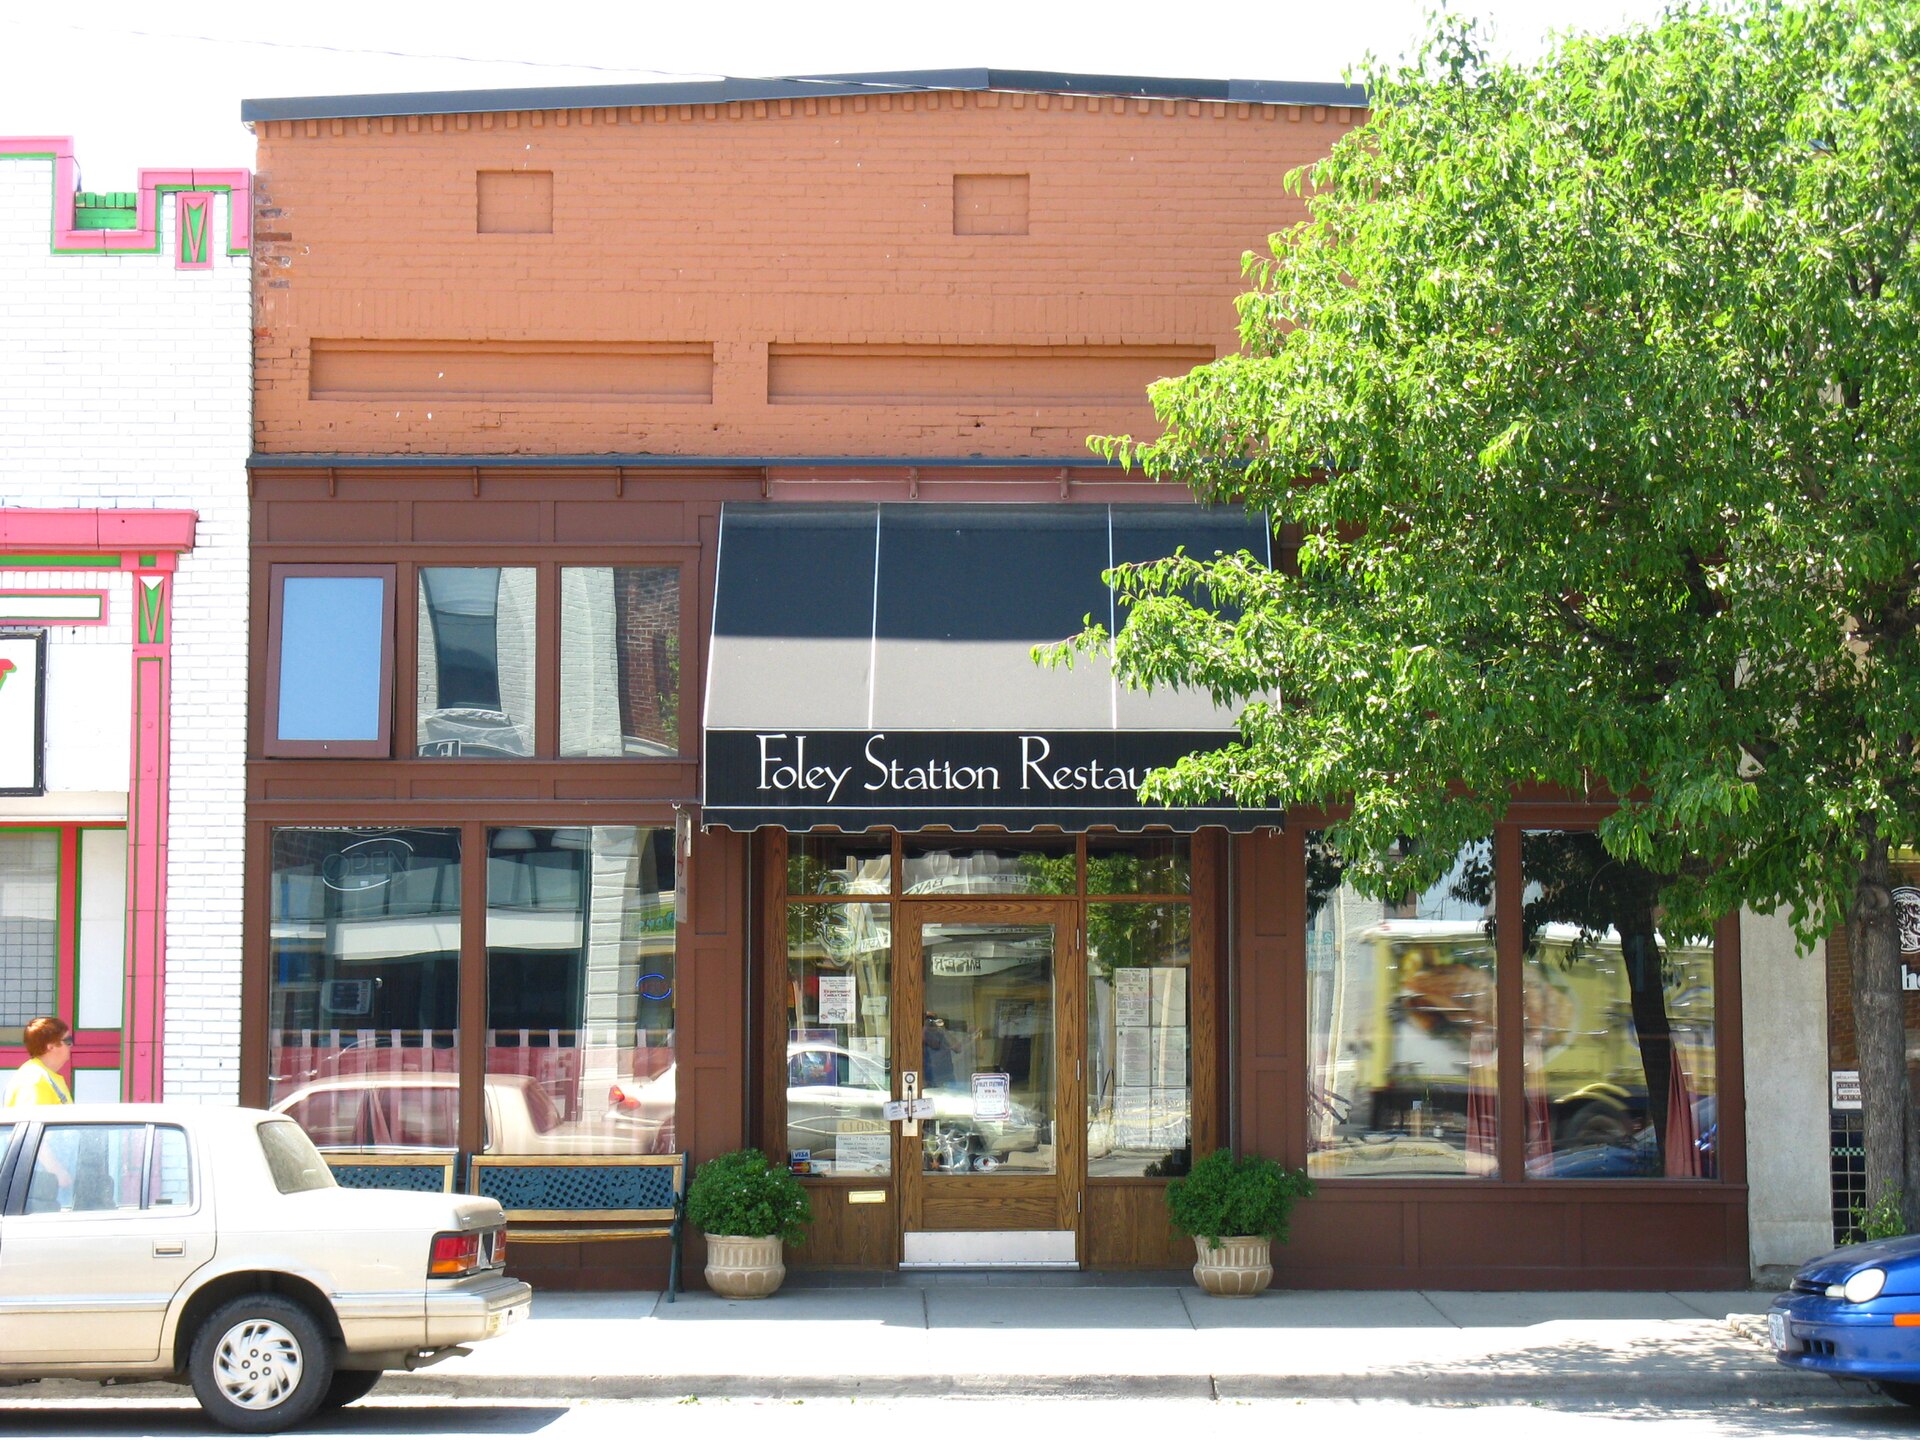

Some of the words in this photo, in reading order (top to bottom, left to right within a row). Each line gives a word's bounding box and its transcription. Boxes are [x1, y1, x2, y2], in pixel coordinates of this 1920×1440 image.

[756, 733, 851, 803] Foley
[864, 733, 1000, 791] Station
[1018, 735, 1153, 791] Restau
[1900, 964, 1920, 991] h
